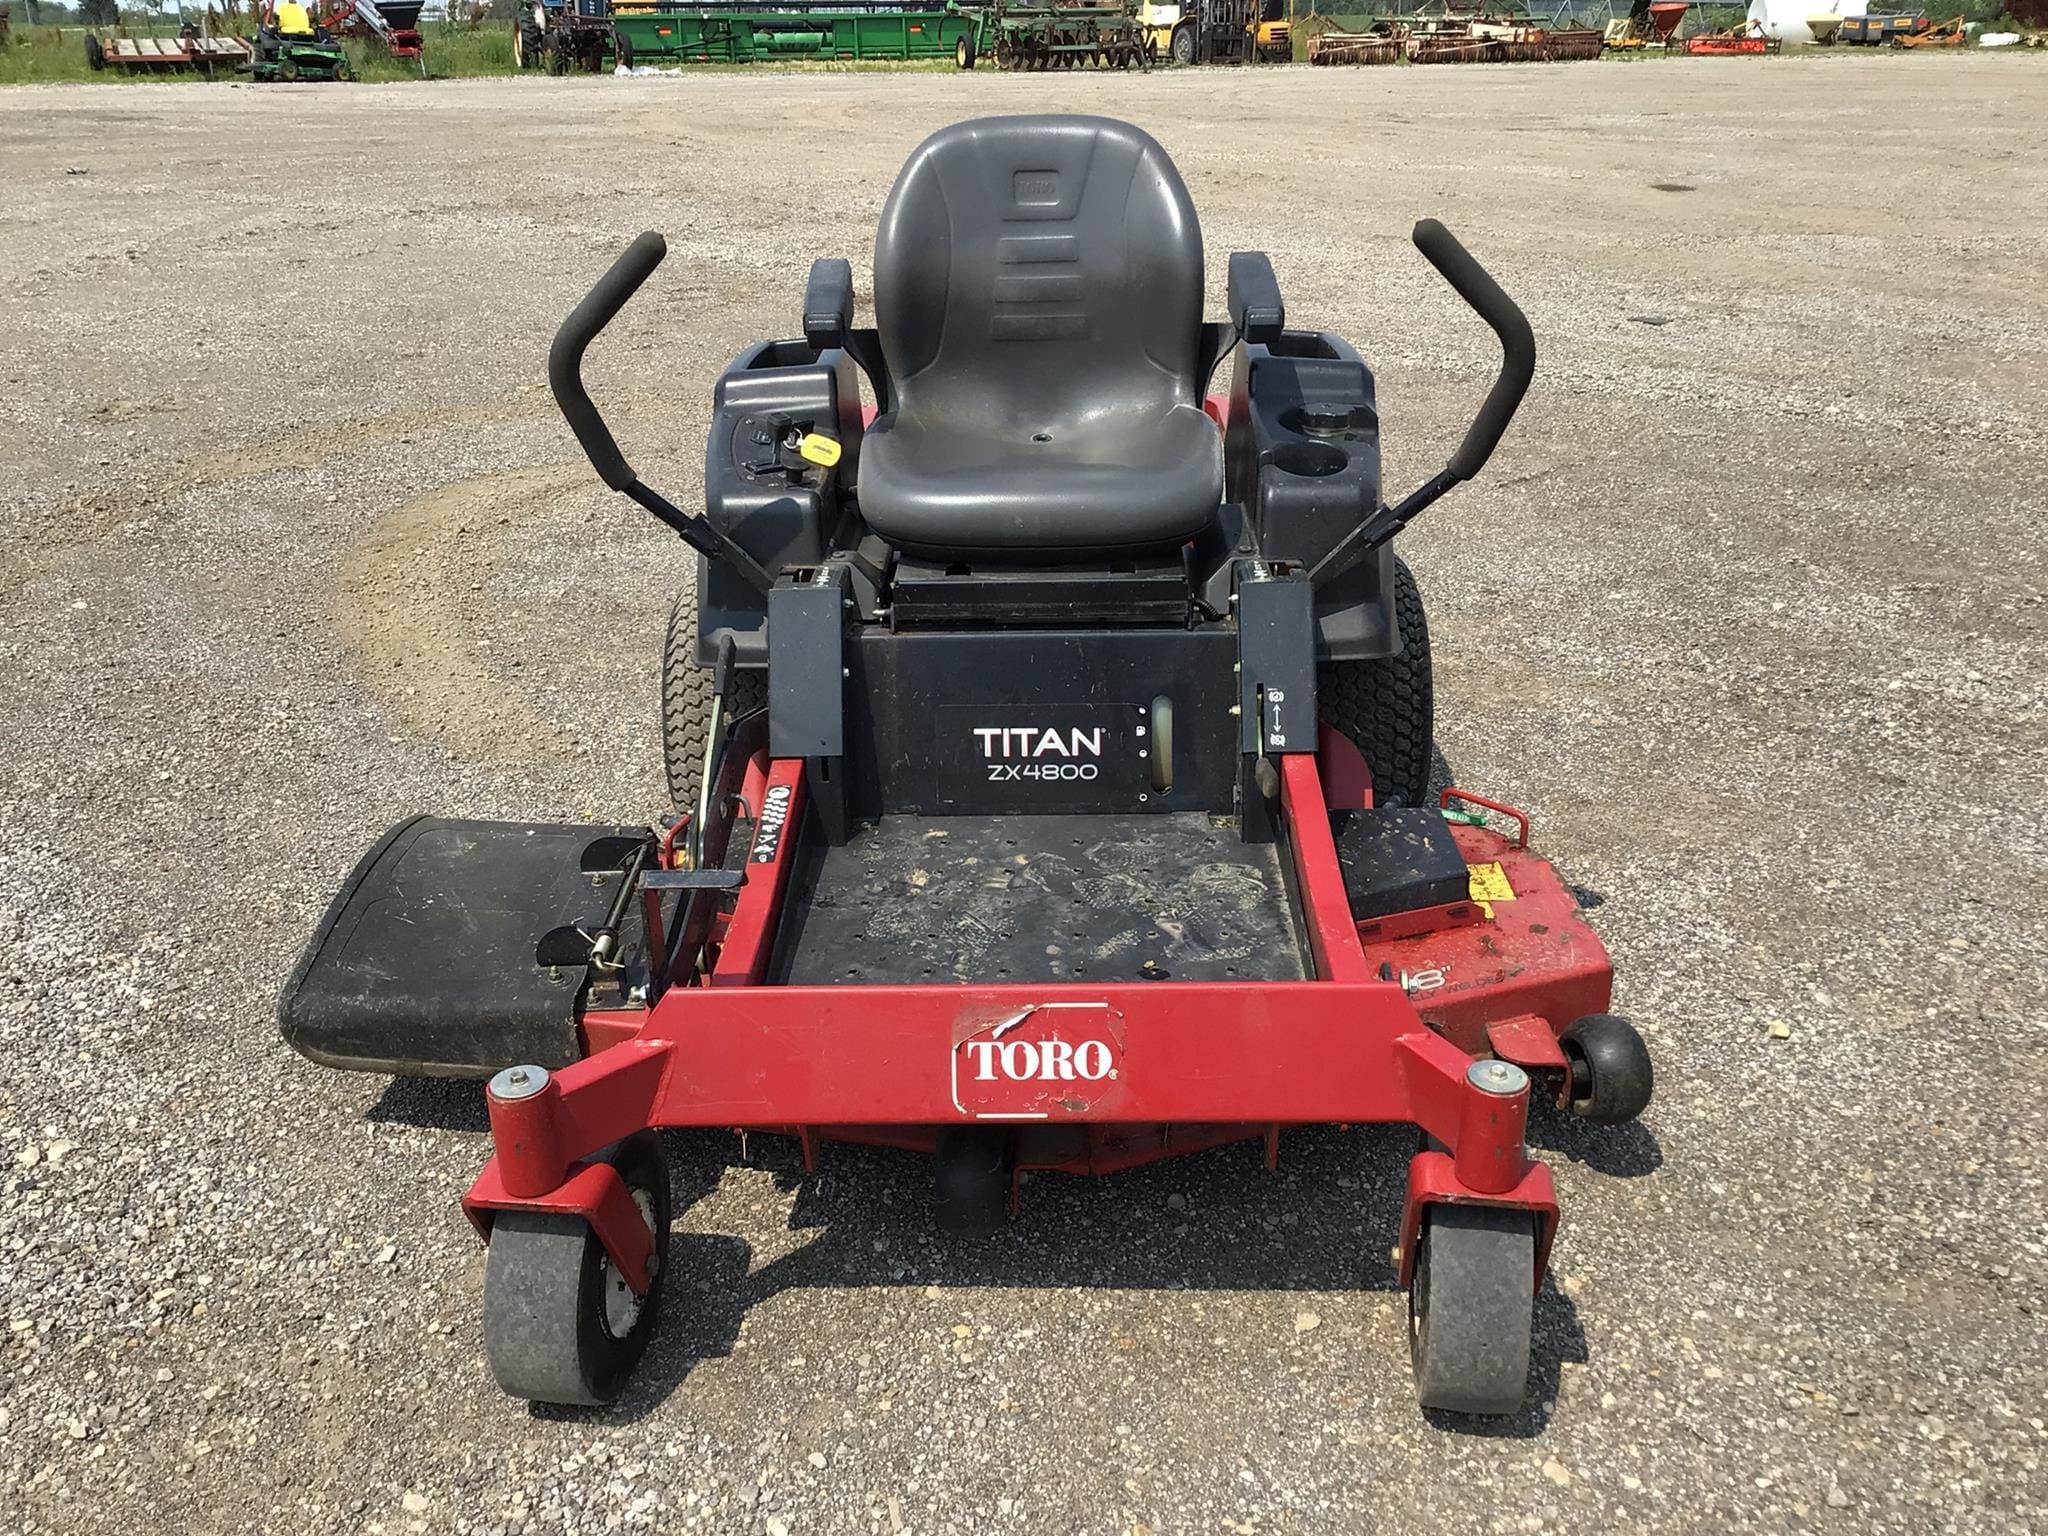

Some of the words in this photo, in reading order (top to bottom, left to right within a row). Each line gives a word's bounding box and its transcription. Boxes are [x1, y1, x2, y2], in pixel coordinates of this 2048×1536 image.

[973, 727, 1103, 758] TITAN
[987, 764, 1099, 781] ZX4800
[967, 1040, 1113, 1081] TORO
